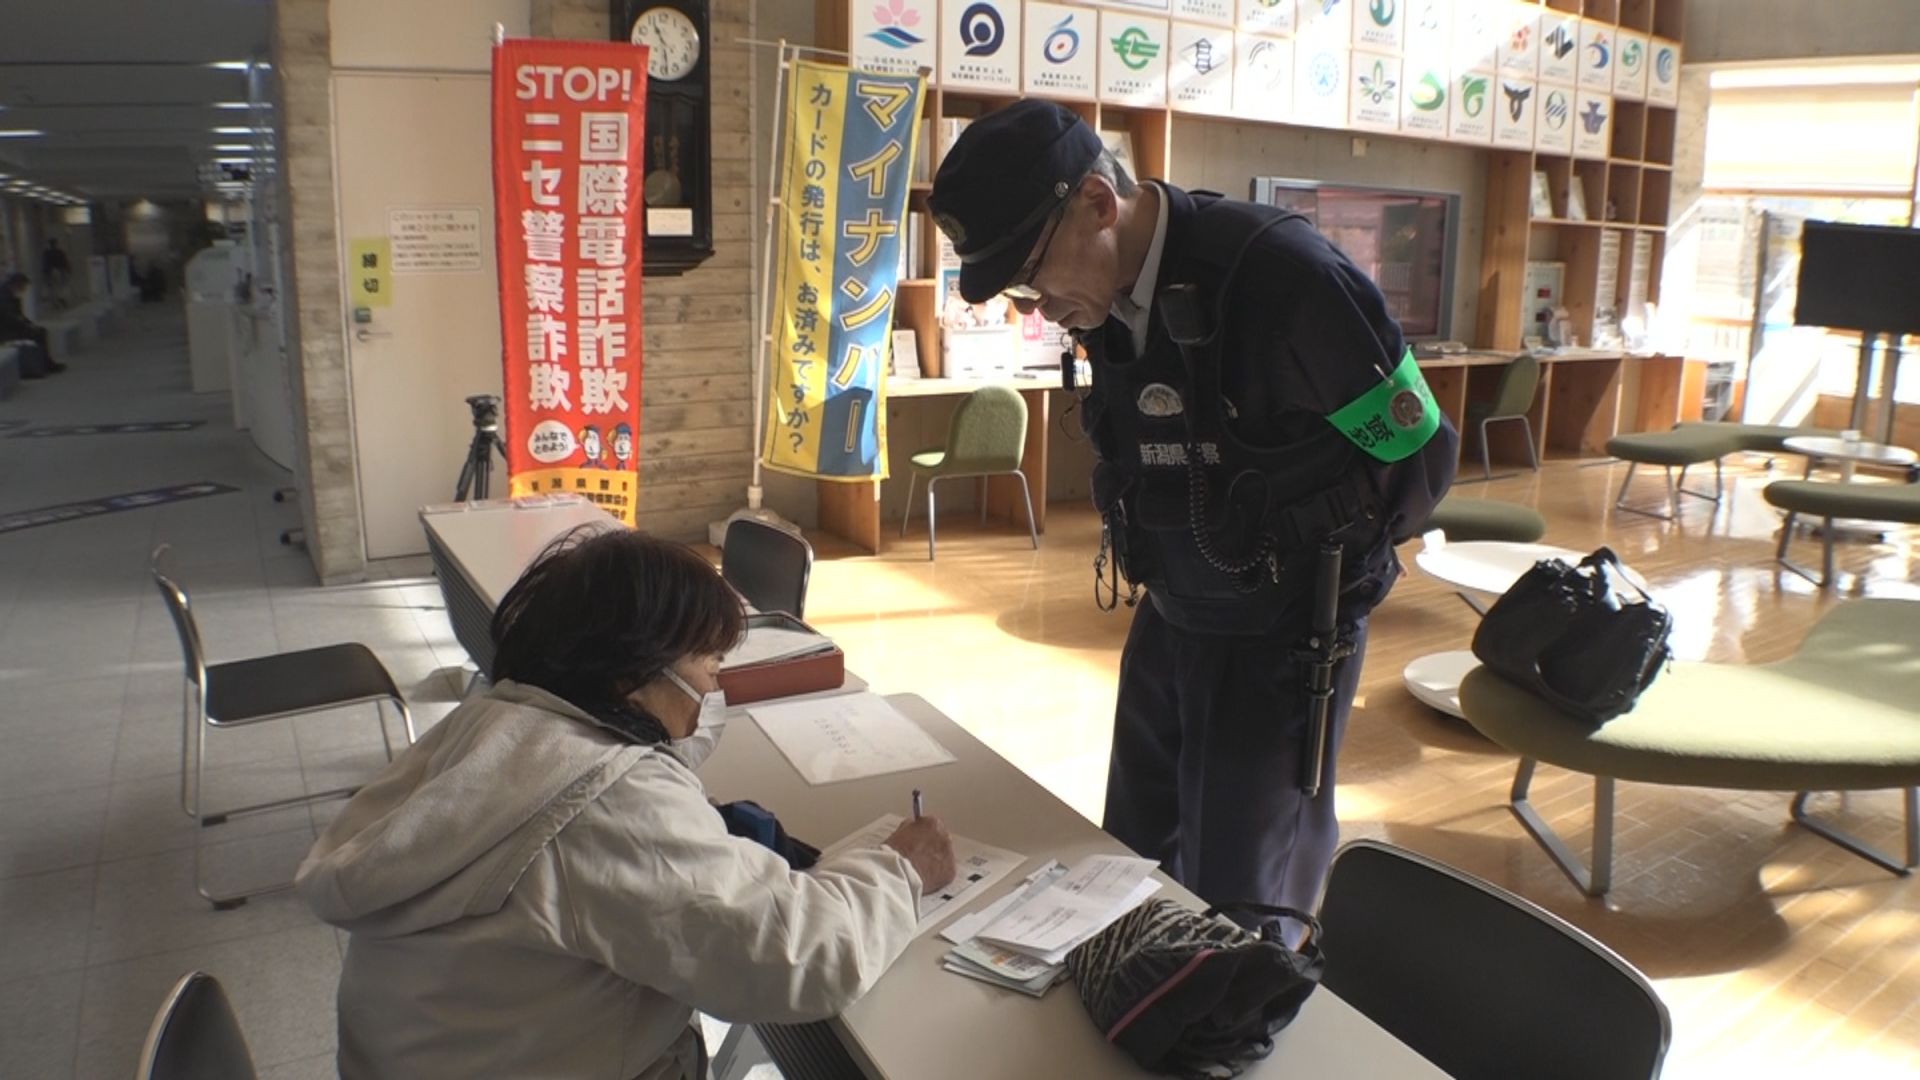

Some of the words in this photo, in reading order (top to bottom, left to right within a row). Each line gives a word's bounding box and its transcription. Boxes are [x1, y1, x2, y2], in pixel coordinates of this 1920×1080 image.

[516, 64, 632, 101] STOP!
[521, 113, 572, 411] ニセ警察詐欺
[577, 112, 630, 415] 国際電話詐欺
[831, 79, 914, 453] マイナンバー
[1139, 441, 1221, 466] 新潟県察
